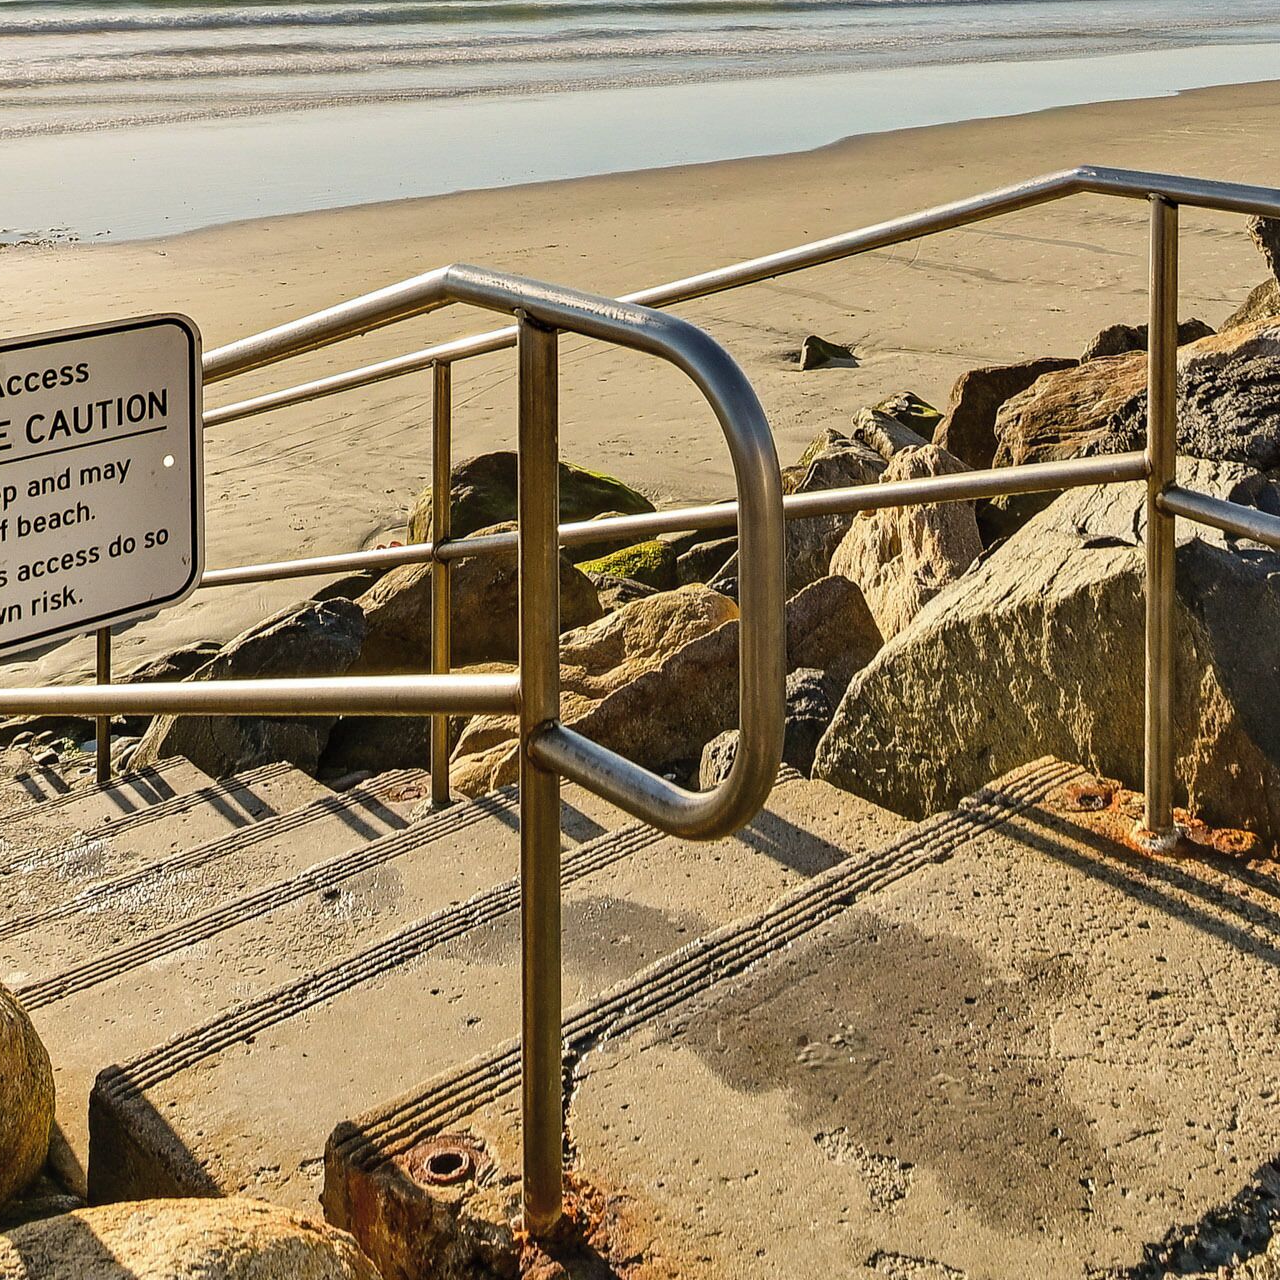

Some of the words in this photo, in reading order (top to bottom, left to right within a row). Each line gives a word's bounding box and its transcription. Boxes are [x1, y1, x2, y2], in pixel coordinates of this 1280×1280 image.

[26, 390, 168, 444] CAUTION
[28, 468, 70, 496] and
[80, 459, 130, 484] may
[17, 504, 95, 537] beach.
[18, 550, 99, 581] access
[109, 533, 135, 557] do
[144, 528, 169, 548] so
[32, 586, 83, 616] risk.
